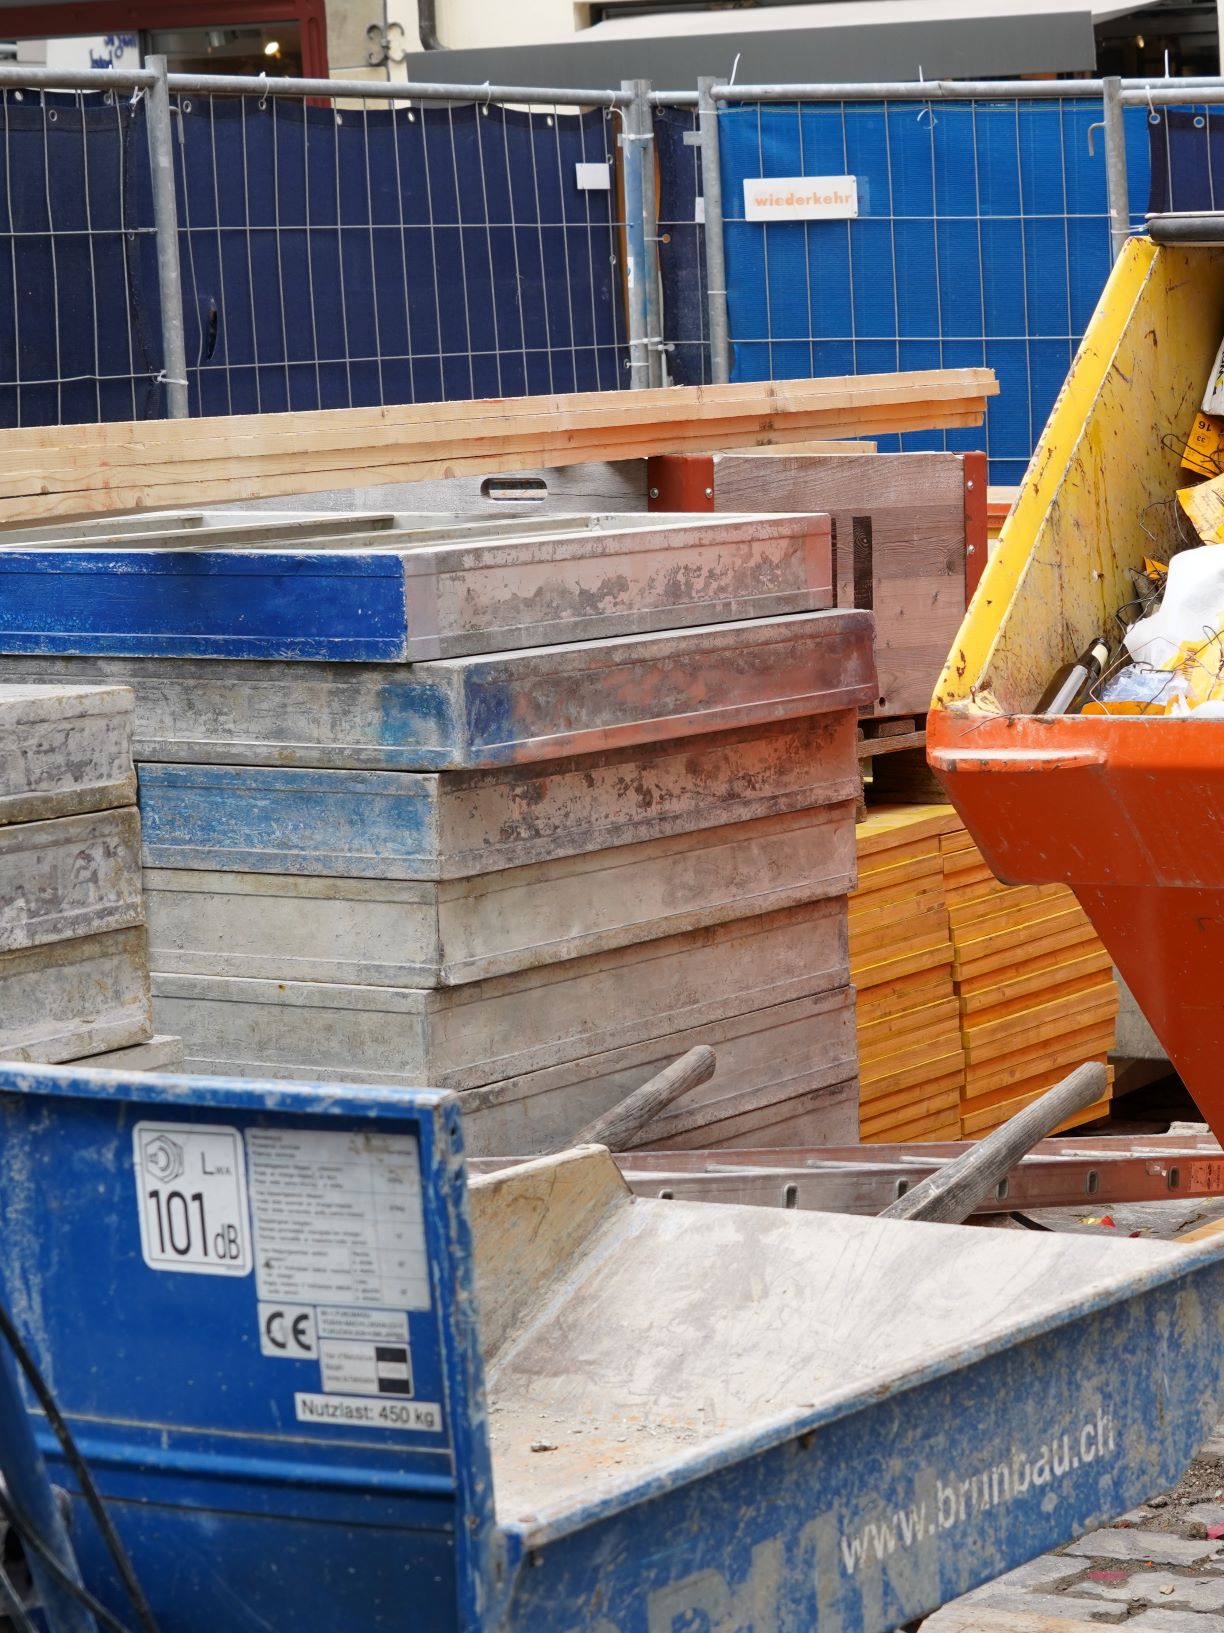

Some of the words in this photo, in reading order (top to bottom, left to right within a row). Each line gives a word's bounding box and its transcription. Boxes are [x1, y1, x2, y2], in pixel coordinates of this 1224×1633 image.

[754, 191, 852, 206] wiederkehr
[1198, 420, 1212, 432] 16
[149, 1190, 208, 1257] 101
[214, 1223, 240, 1260] dB
[266, 1311, 312, 1351] CE
[301, 1400, 374, 1420] Nutzlast:
[378, 1405, 410, 1423] 450
[414, 1408, 435, 1428] kg
[840, 1408, 1115, 1574] www.brunbau.ch
